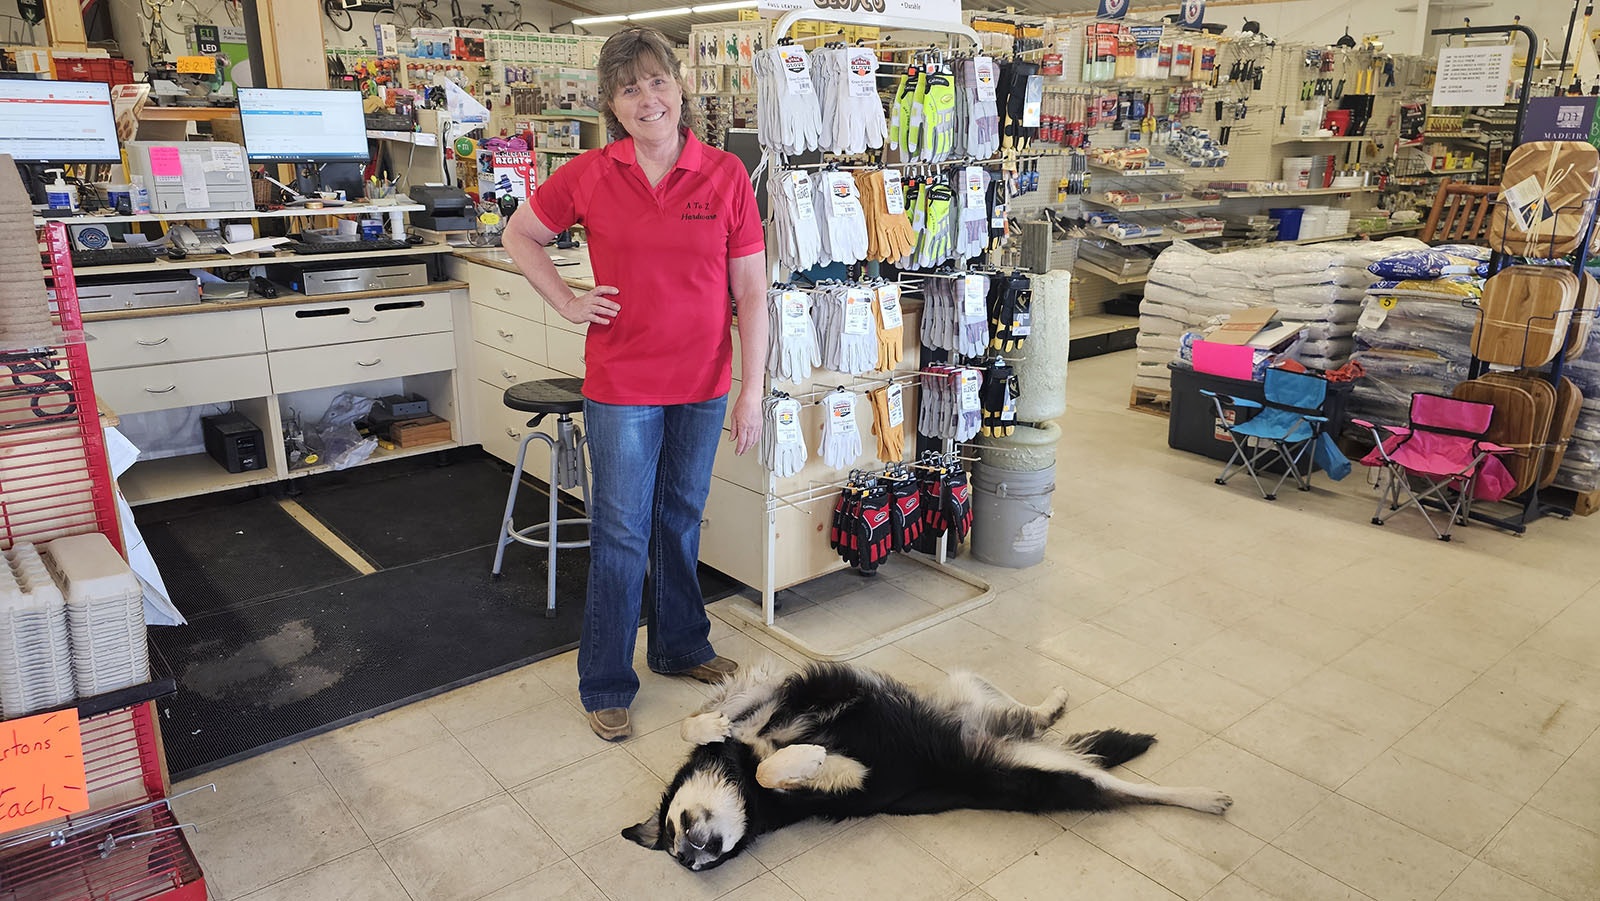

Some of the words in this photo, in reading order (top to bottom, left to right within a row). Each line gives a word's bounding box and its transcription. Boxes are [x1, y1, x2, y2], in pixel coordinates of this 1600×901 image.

[201, 44, 217, 52] LED
[1544, 132, 1589, 140] MADEIRA
[496, 157, 525, 165] RIGHT
[693, 201, 703, 209] To
[704, 202, 710, 210] Z
[1383, 297, 1392, 308] 5
[0, 729, 51, 760] rtons
